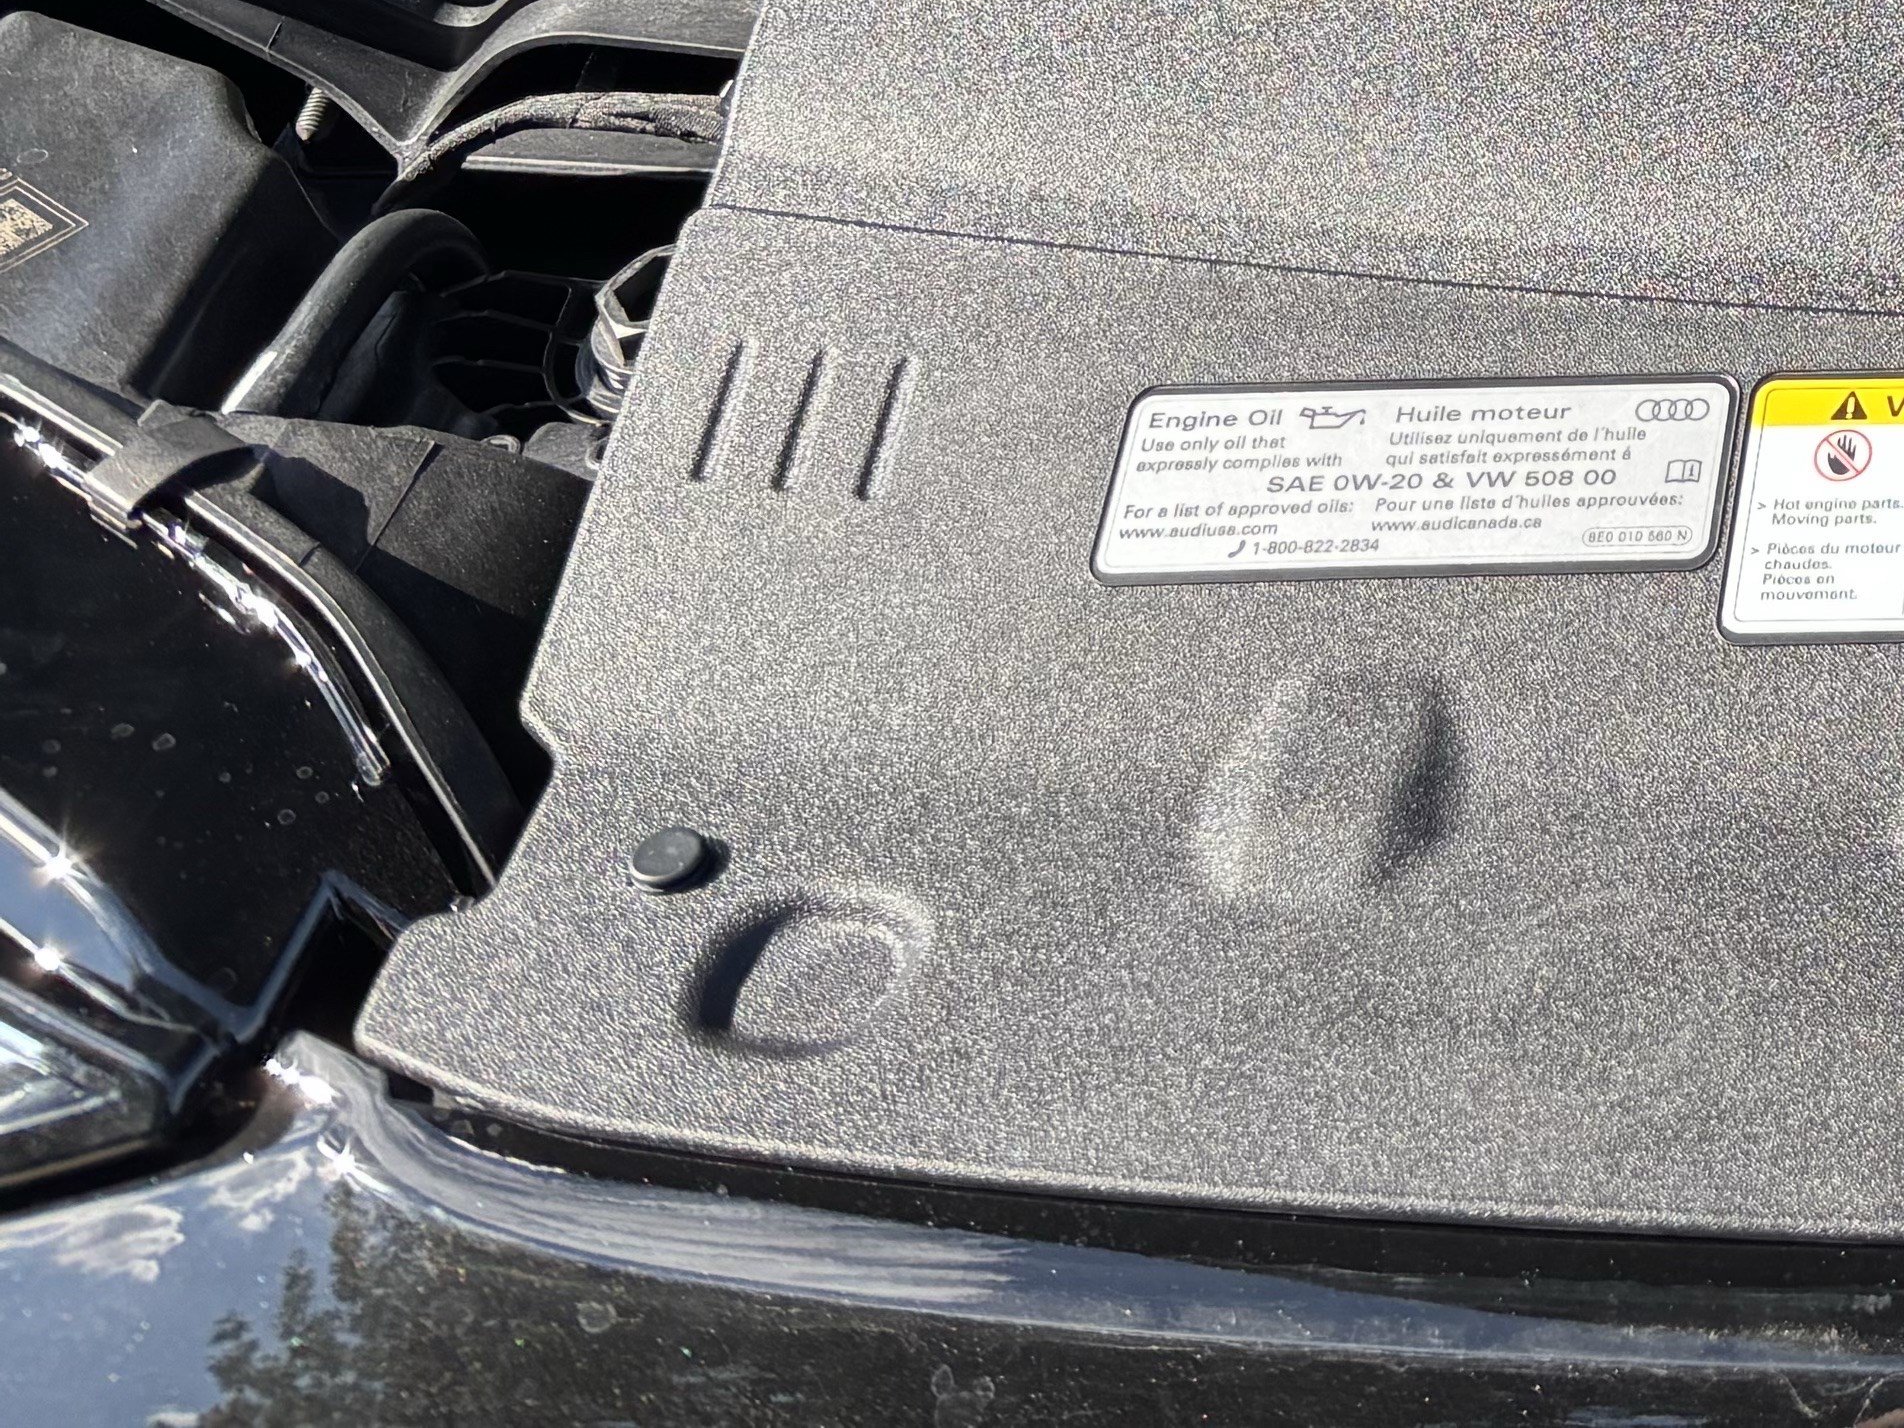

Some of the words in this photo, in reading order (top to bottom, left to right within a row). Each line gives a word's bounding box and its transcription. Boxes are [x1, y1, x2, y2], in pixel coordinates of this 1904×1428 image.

[1149, 410, 1238, 431] Engine
[1249, 409, 1283, 426] Oil
[1396, 406, 1462, 423] Huile
[1471, 405, 1572, 422] moteur
[1141, 438, 1175, 453] Use
[1180, 437, 1219, 454] only
[1224, 435, 1247, 450] oil
[1251, 435, 1286, 449] that
[1389, 431, 1452, 446] Utilisez
[1457, 429, 1562, 446] uniquement
[1567, 429, 1588, 442] de
[1136, 457, 1219, 474] expressly
[1222, 454, 1300, 472] complies
[1305, 453, 1342, 467] with
[1385, 450, 1415, 468] qui
[1419, 449, 1488, 465] satisfait
[1266, 474, 1324, 493] SAE
[1332, 472, 1423, 492] 0W-20
[1432, 471, 1454, 489] &
[1466, 469, 1516, 488] VW
[1524, 469, 1574, 487] 508
[1583, 468, 1617, 486] 00
[1123, 504, 1154, 520] For
[1157, 506, 1168, 517] a
[1173, 503, 1199, 517] list
[1205, 501, 1225, 517] of
[1228, 500, 1312, 520] approved
[1317, 500, 1354, 514] oils:
[1375, 497, 1417, 513] Pour
[1422, 497, 1454, 511] une
[1459, 495, 1496, 510] liste
[1576, 492, 1684, 510] approuvées:
[1773, 498, 1800, 511] Hot
[1805, 497, 1858, 512] engine
[1861, 497, 1904, 511] parts.
[1370, 516, 1542, 533] www.audicanada.ca
[1772, 512, 1829, 527] Moving
[1834, 513, 1877, 527] parts.
[1119, 522, 1278, 540] www.audiusa.com
[1253, 538, 1380, 556] 1-800-822-2834
[1820, 543, 1839, 555] du
[1845, 543, 1901, 554] moteur
[1765, 559, 1832, 570] chaudes.
[1816, 575, 1835, 584] en
[1760, 588, 1858, 601] mouvement.
